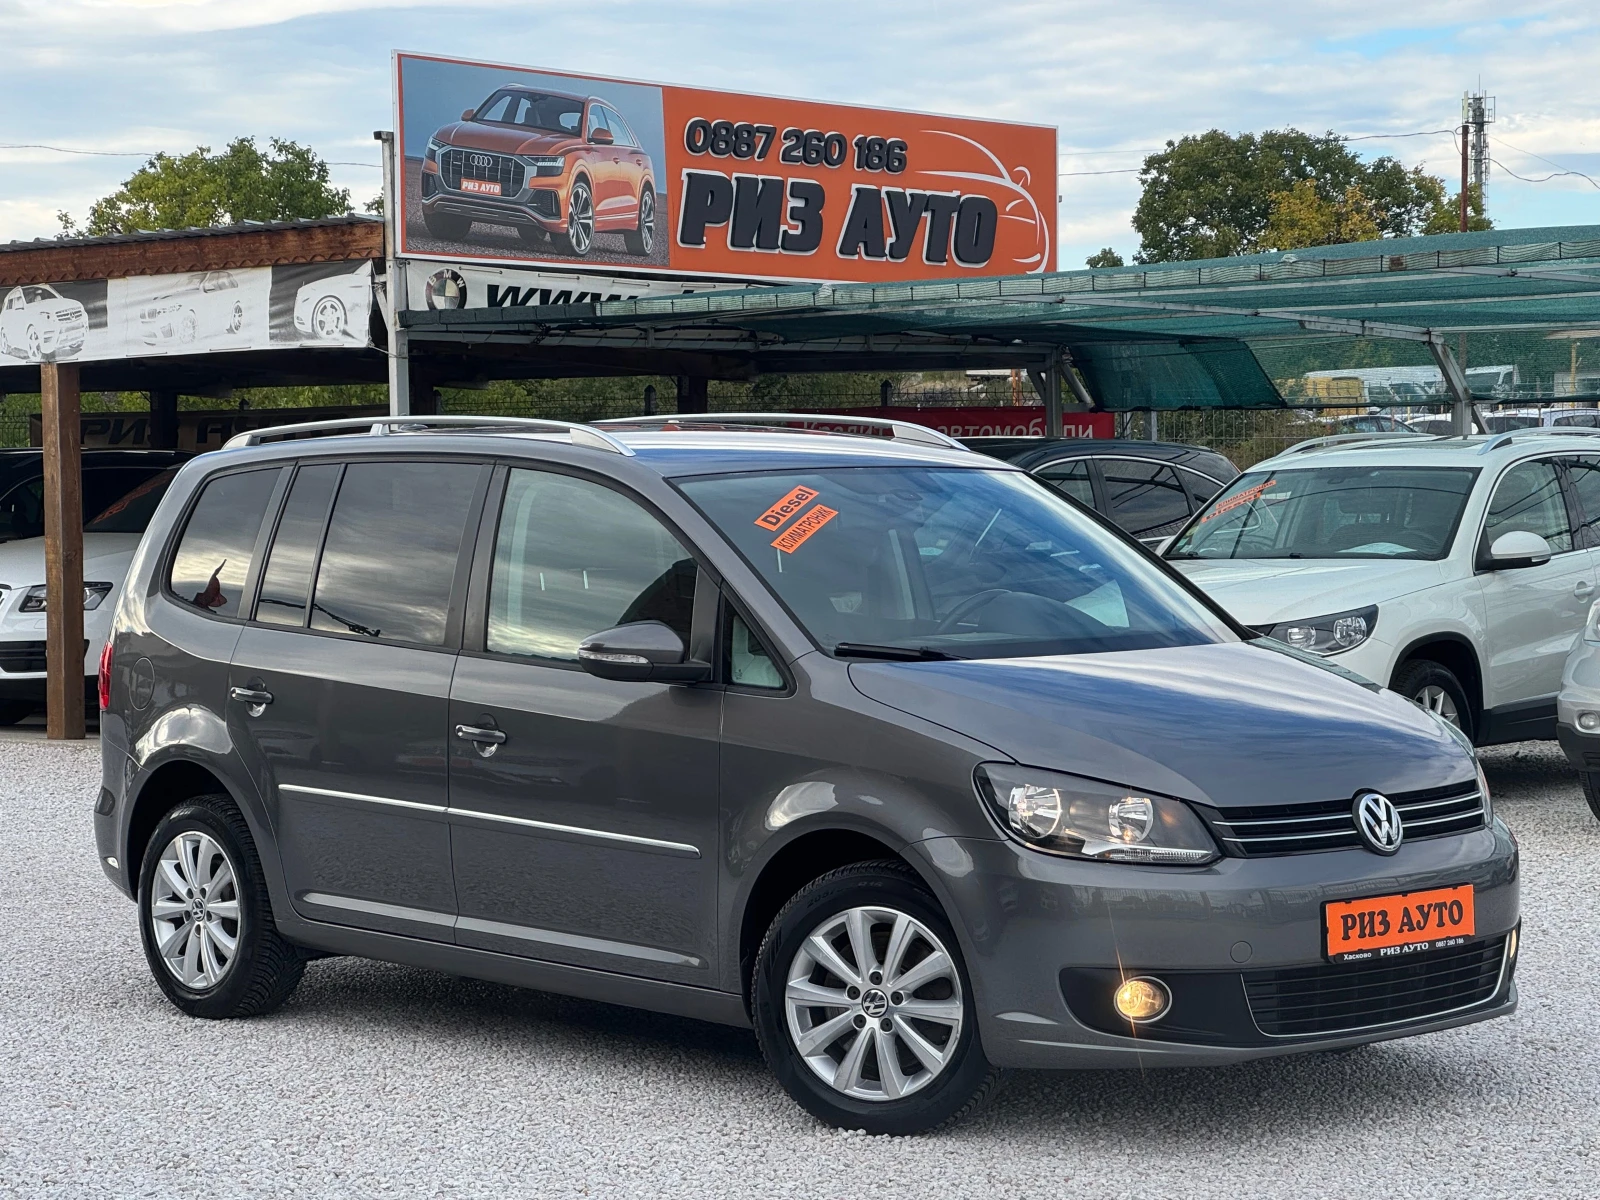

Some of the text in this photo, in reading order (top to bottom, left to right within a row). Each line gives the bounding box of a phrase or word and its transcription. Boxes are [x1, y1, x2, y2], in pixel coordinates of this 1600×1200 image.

[684, 117, 908, 175] 0887 260 186
[462, 181, 500, 193] РИЗ АУТО
[677, 168, 999, 268] РИЗ АУТО
[761, 488, 814, 527] Diesel
[777, 506, 834, 550] КЛИМАТРОНИК
[1341, 900, 1464, 940] РИЗ АУТО
[1343, 952, 1372, 961] Хасково
[1380, 942, 1429, 956] РИЗ АУТО
